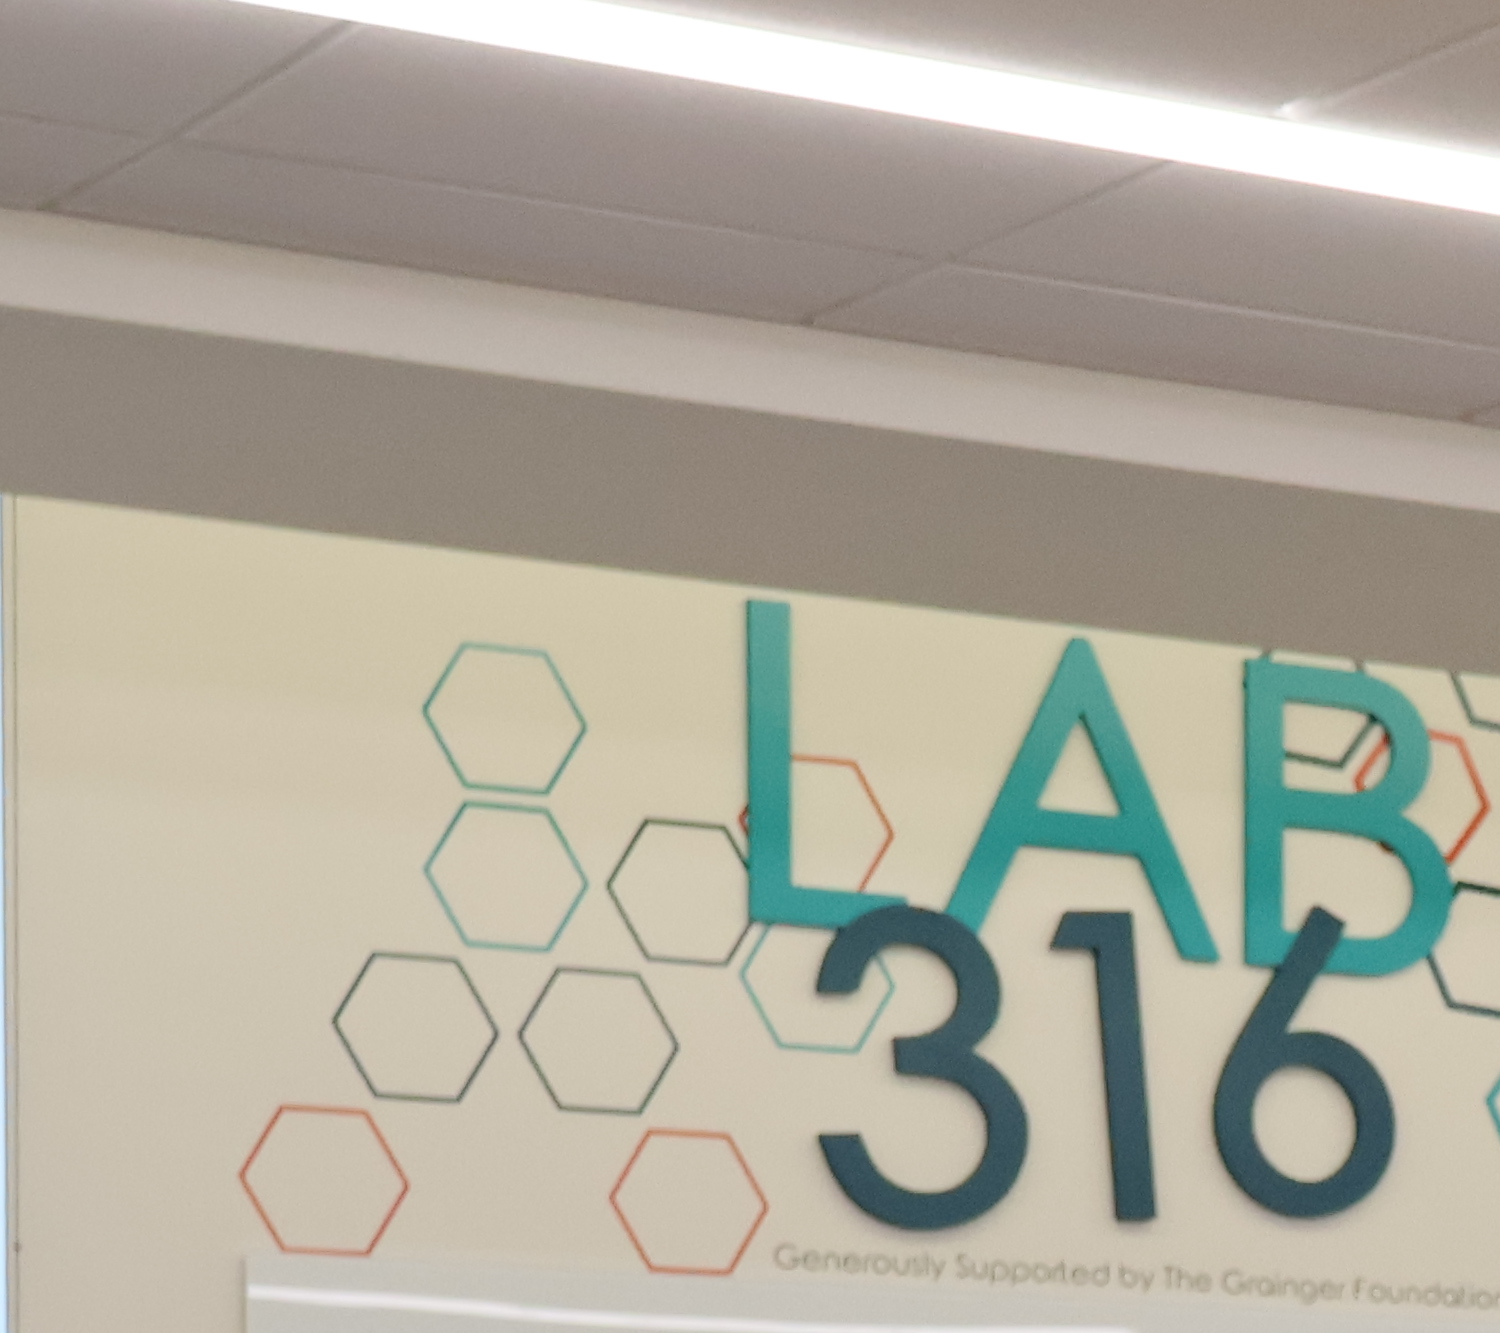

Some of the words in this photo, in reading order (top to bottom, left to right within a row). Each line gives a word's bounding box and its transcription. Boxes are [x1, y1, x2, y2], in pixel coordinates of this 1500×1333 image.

[746, 599, 1453, 977] LAB
[815, 904, 1396, 1231] 316
[773, 1242, 947, 1282] Generously
[954, 1252, 1111, 1288] Supported
[1118, 1265, 1154, 1292] by
[1163, 1265, 1213, 1294] The
[1221, 1268, 1346, 1306] Grainger
